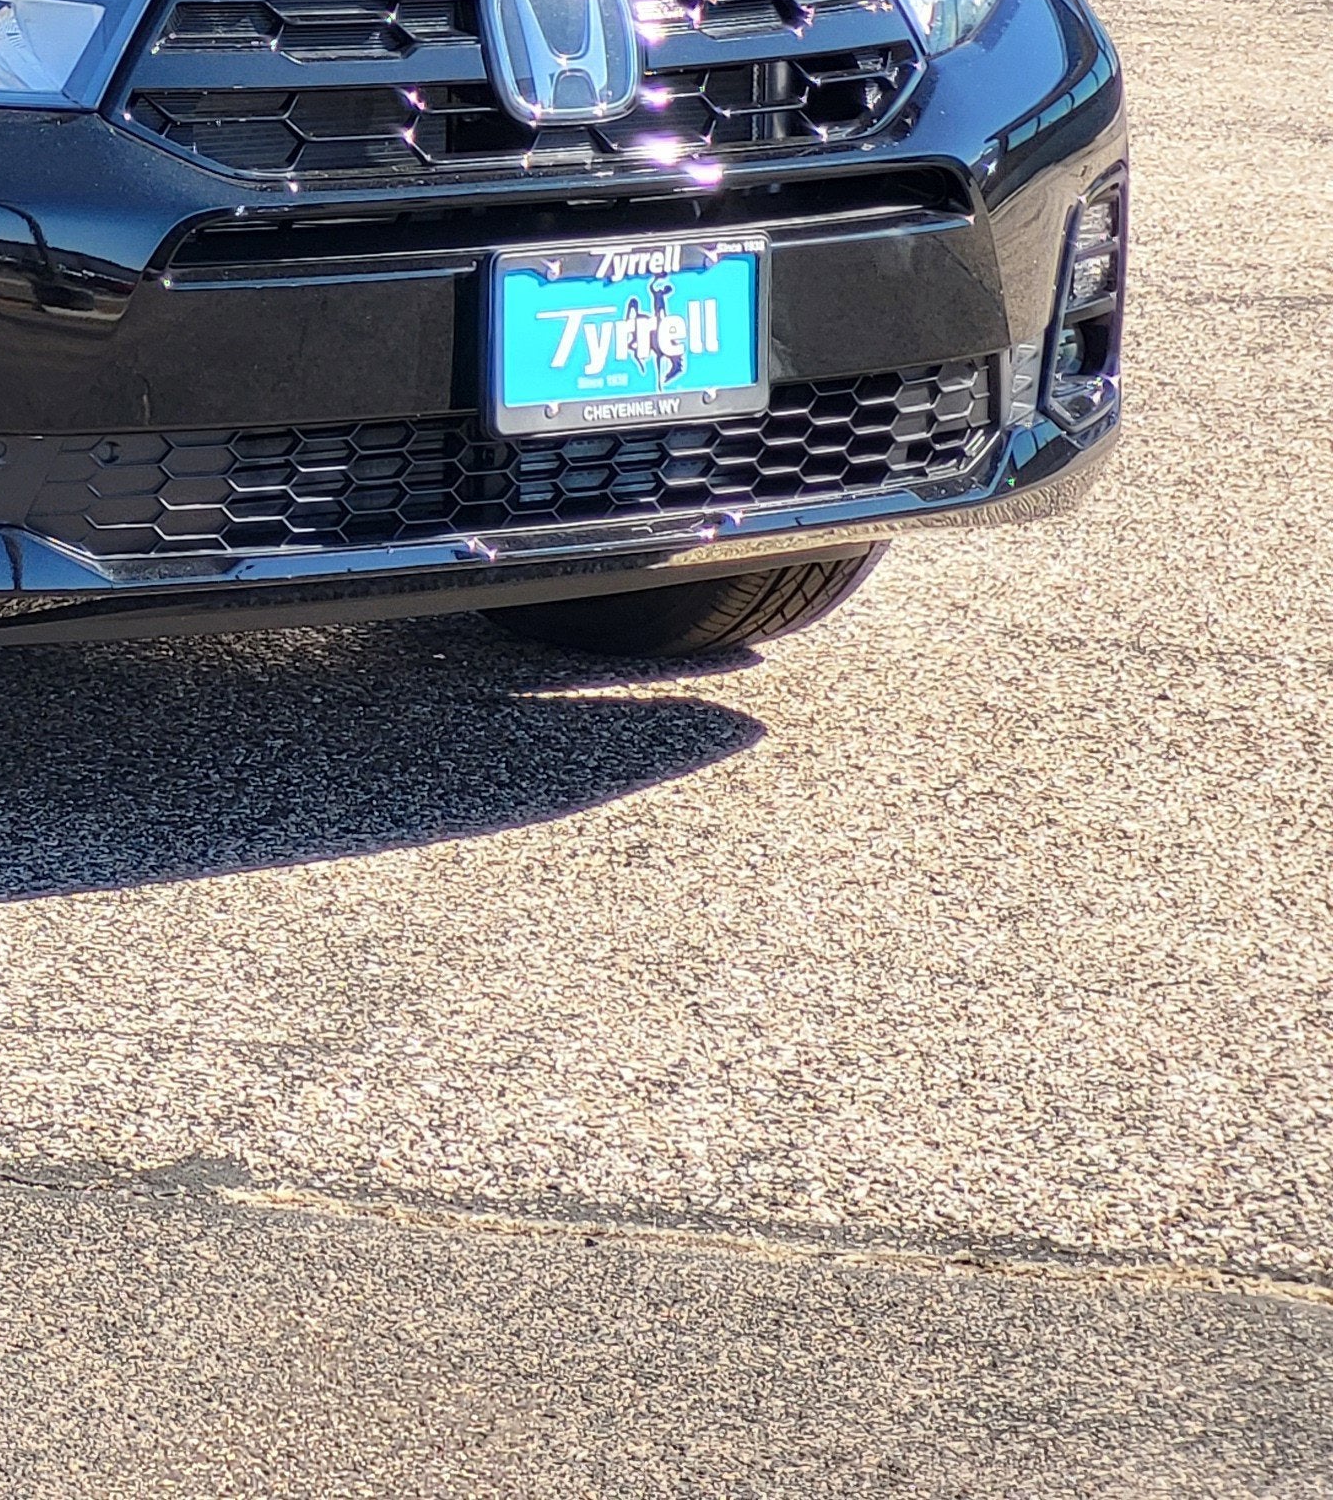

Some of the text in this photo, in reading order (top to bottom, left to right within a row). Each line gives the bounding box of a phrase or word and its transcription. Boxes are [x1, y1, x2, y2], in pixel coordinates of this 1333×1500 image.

[590, 245, 681, 281] Tyrrell
[535, 298, 719, 375] Tyrrell
[583, 397, 680, 421] CHEYENNE, WY
